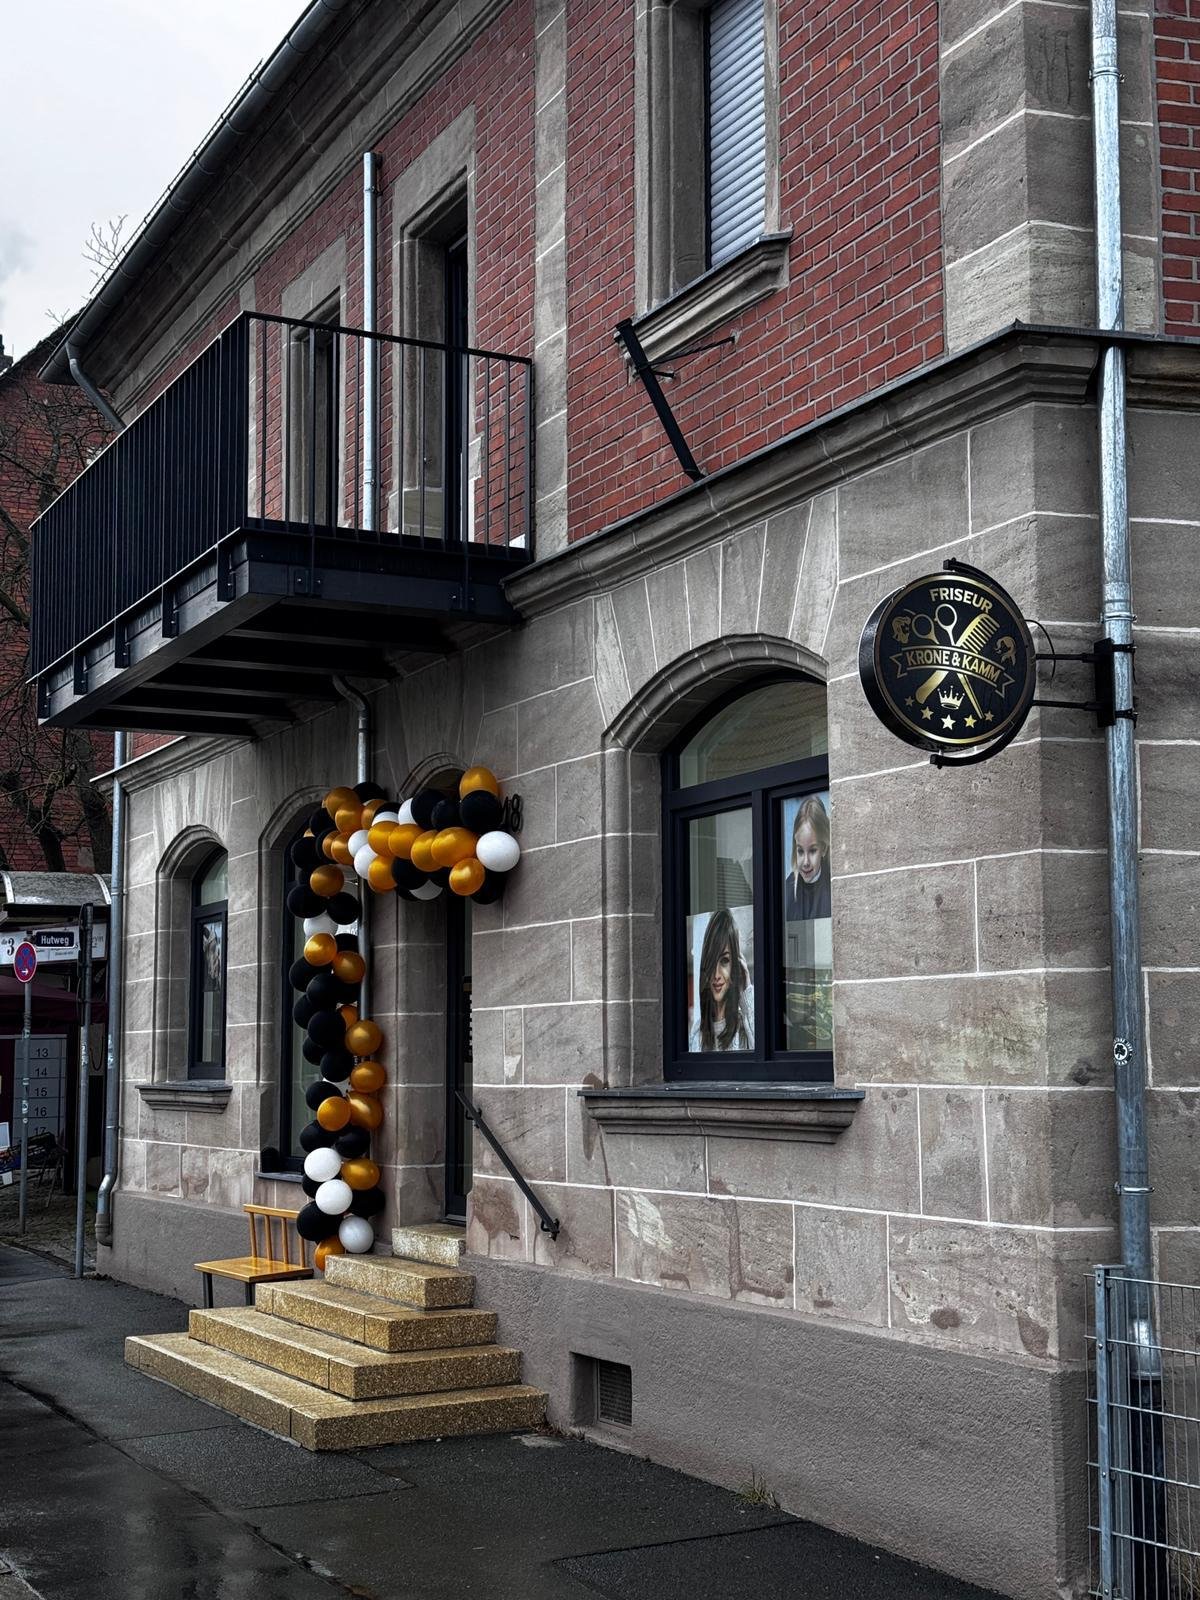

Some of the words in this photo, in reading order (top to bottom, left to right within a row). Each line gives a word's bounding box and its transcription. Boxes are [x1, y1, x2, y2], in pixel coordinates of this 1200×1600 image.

[929, 587, 993, 613] FRISEUR
[906, 649, 951, 667] KRONE
[951, 651, 961, 667] &
[961, 654, 1001, 682] KAMM
[41, 935, 70, 947] Hutweg
[7, 938, 15, 956] 3
[36, 1048, 49, 1058] 13
[35, 1067, 48, 1077] 14
[34, 1087, 48, 1097] 15
[34, 1107, 47, 1117] 16
